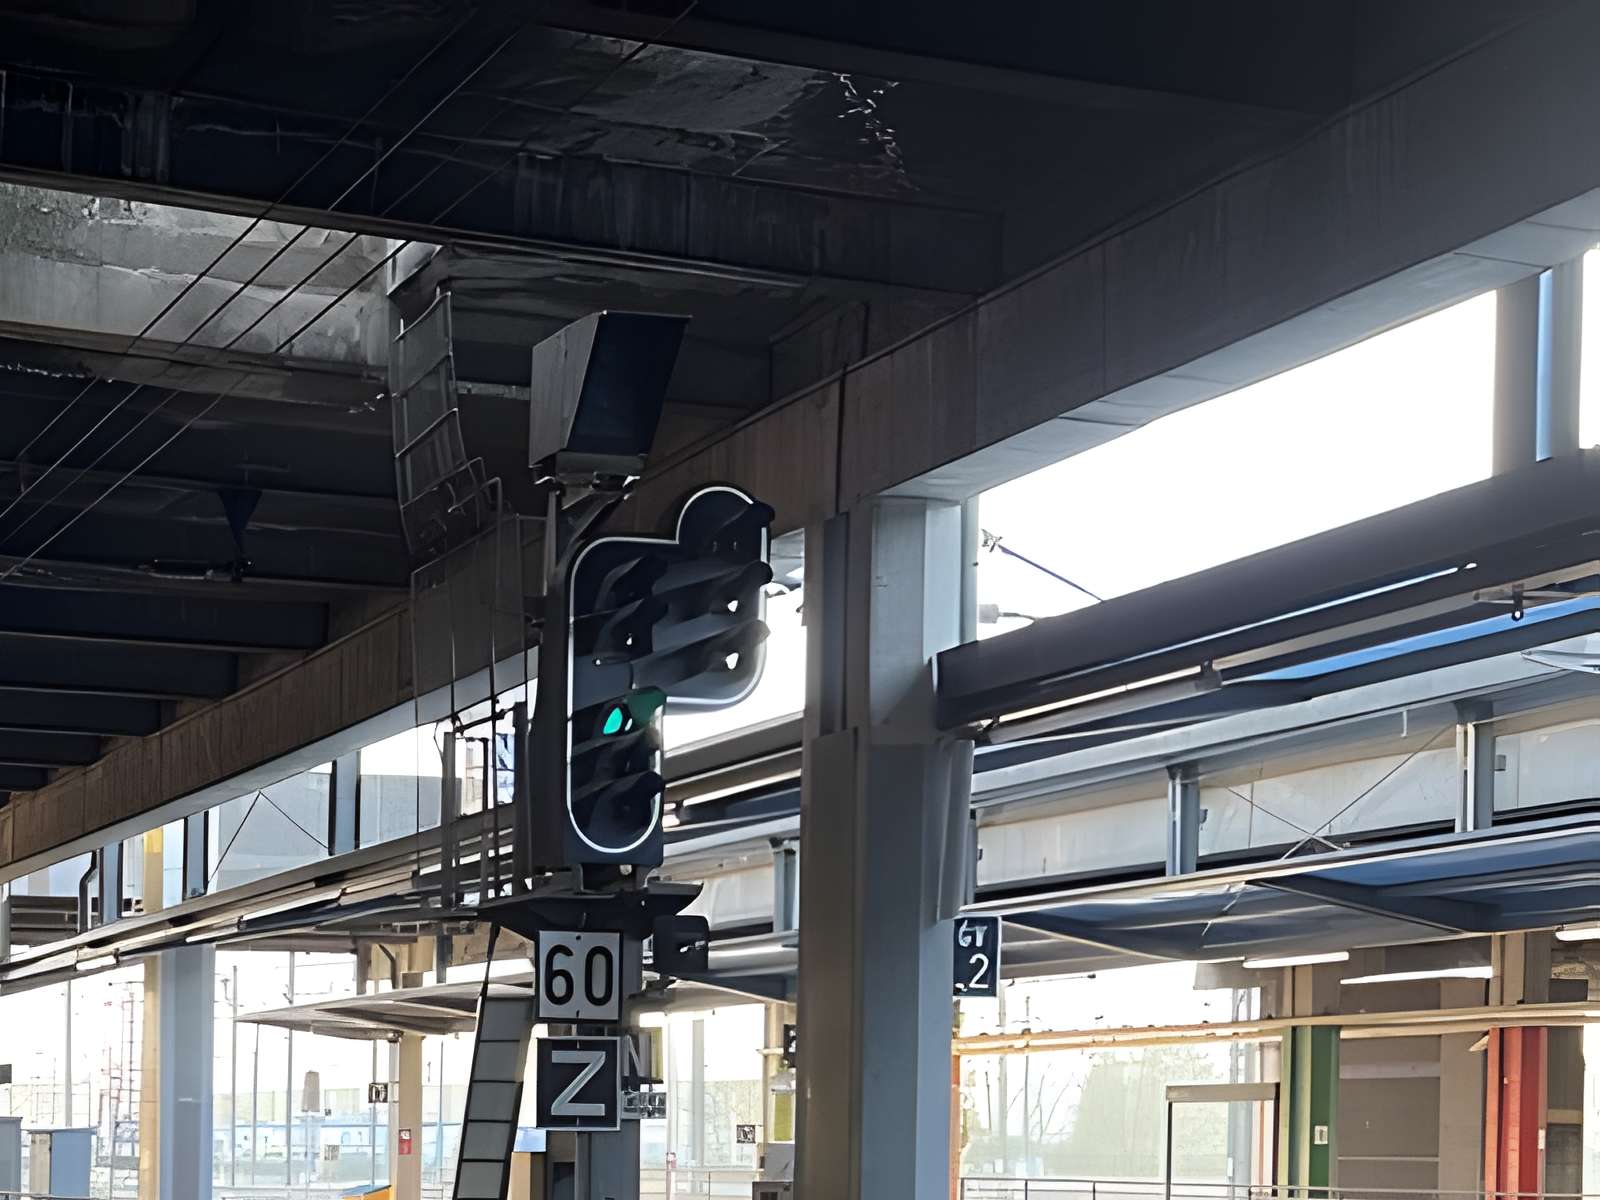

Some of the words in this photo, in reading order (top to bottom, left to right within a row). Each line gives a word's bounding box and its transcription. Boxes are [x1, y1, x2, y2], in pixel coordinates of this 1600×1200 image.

[544, 943, 614, 1007] 60
[969, 952, 989, 989] 2
[550, 1050, 606, 1116] Z
